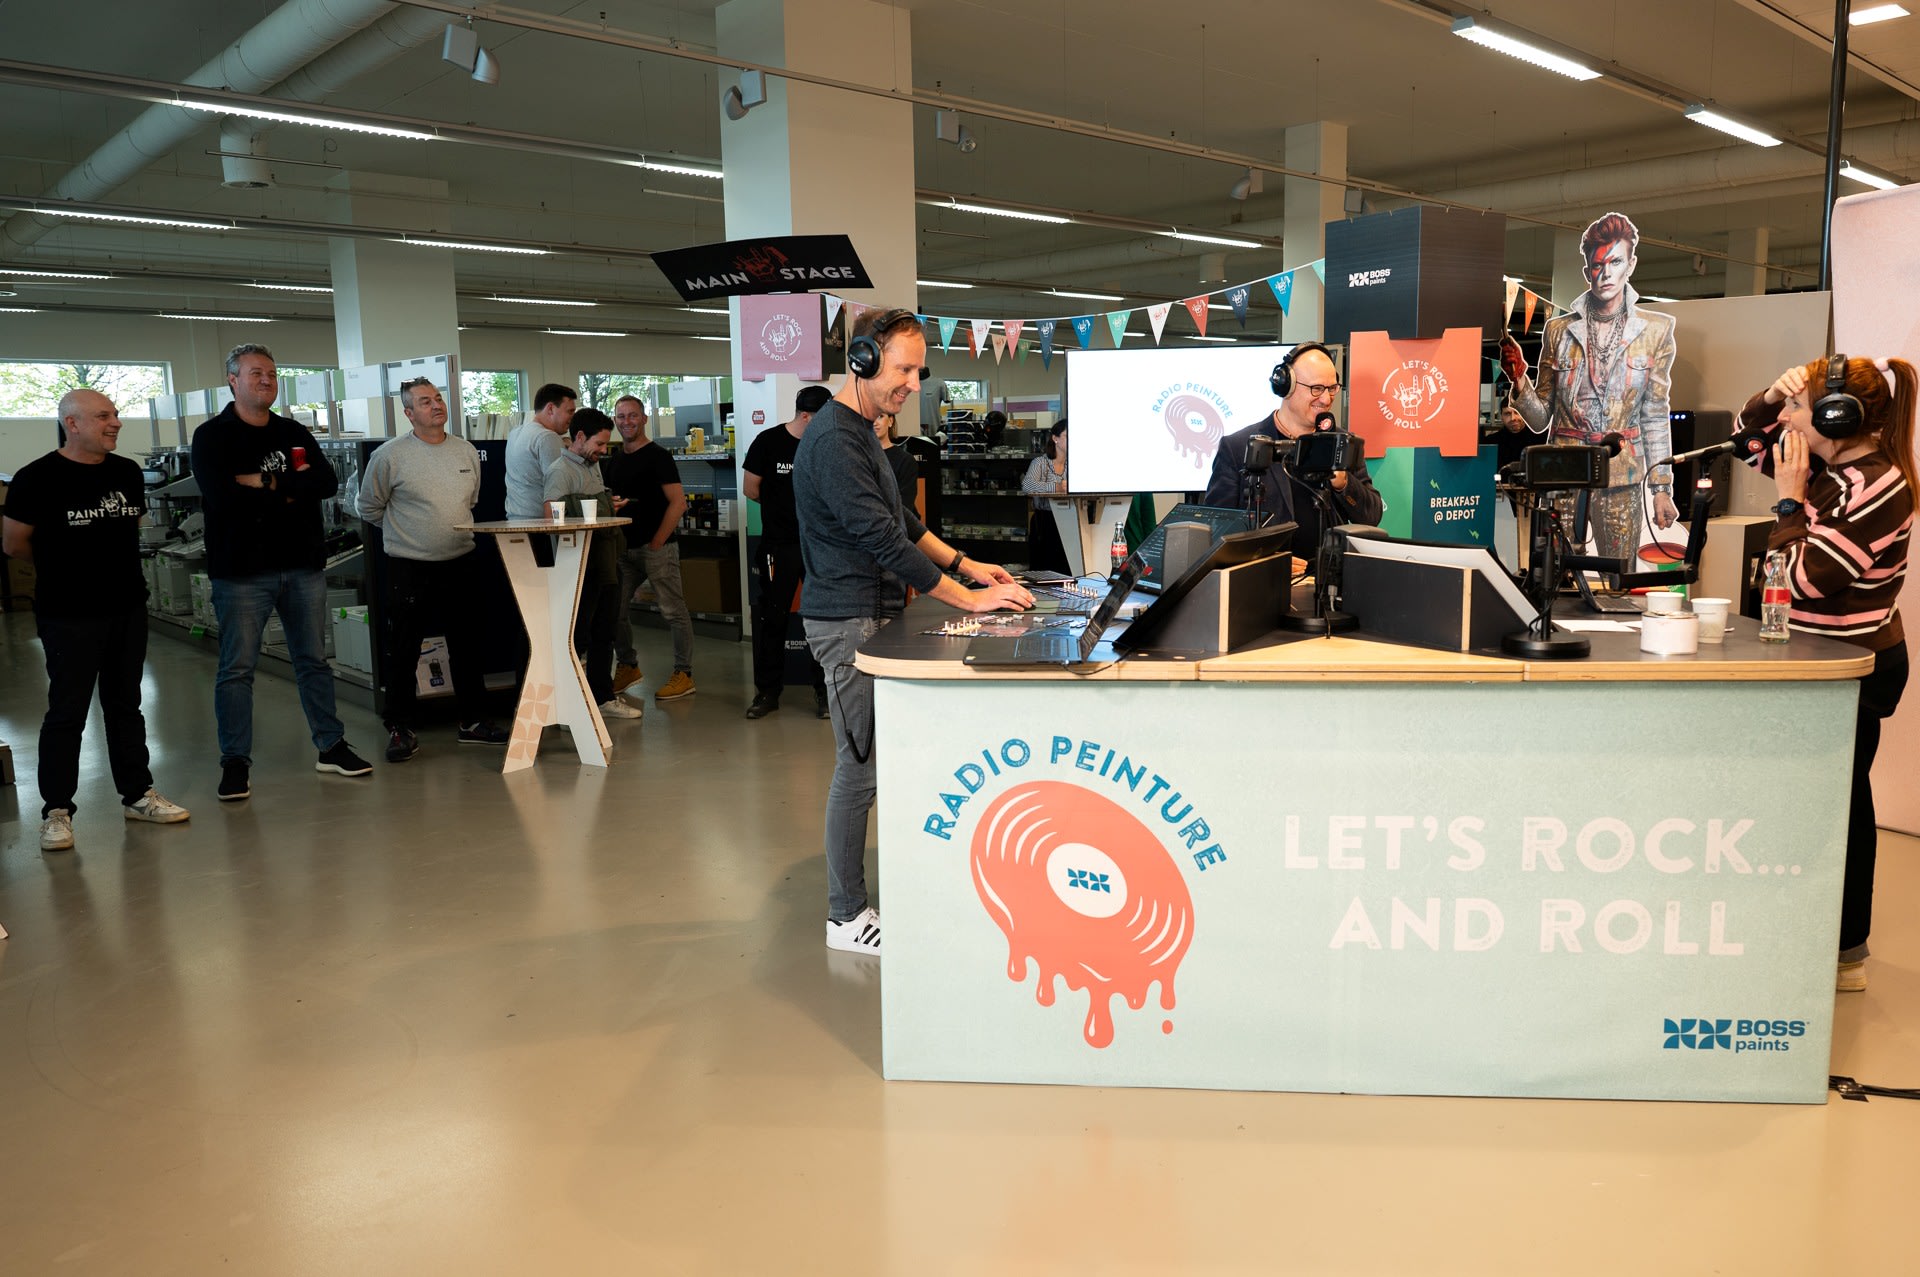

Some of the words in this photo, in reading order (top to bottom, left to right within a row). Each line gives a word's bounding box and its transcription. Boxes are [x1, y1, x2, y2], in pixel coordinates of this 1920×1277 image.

[685, 272, 750, 291] MAIN
[779, 266, 856, 280] STAGE
[1369, 268, 1391, 279] BOSS
[790, 318, 805, 337] ROCK
[759, 341, 771, 356] AND
[770, 354, 787, 362] ROLL
[1402, 360, 1430, 370] LET'S
[1429, 366, 1449, 393] ROCK
[1152, 383, 1181, 412] RADIO
[1186, 382, 1233, 418] PEINTURE
[1378, 400, 1394, 420] AND
[1394, 417, 1421, 429] ROLL
[776, 462, 794, 470] PAIN
[1430, 495, 1480, 508] BREAKFAST
[67, 508, 105, 520] PAINT
[1434, 510, 1443, 524] @
[1446, 509, 1475, 521] DEPOT
[923, 738, 1031, 841] RADIO
[1050, 735, 1227, 871] PEINTURE
[1284, 815, 1486, 872] LET'S
[1521, 816, 1802, 875] ROCK...
[1328, 896, 1506, 952] AND
[1540, 898, 1744, 956] ROLL
[1736, 1019, 1806, 1037] BOSS
[1735, 1037, 1790, 1054] paints
